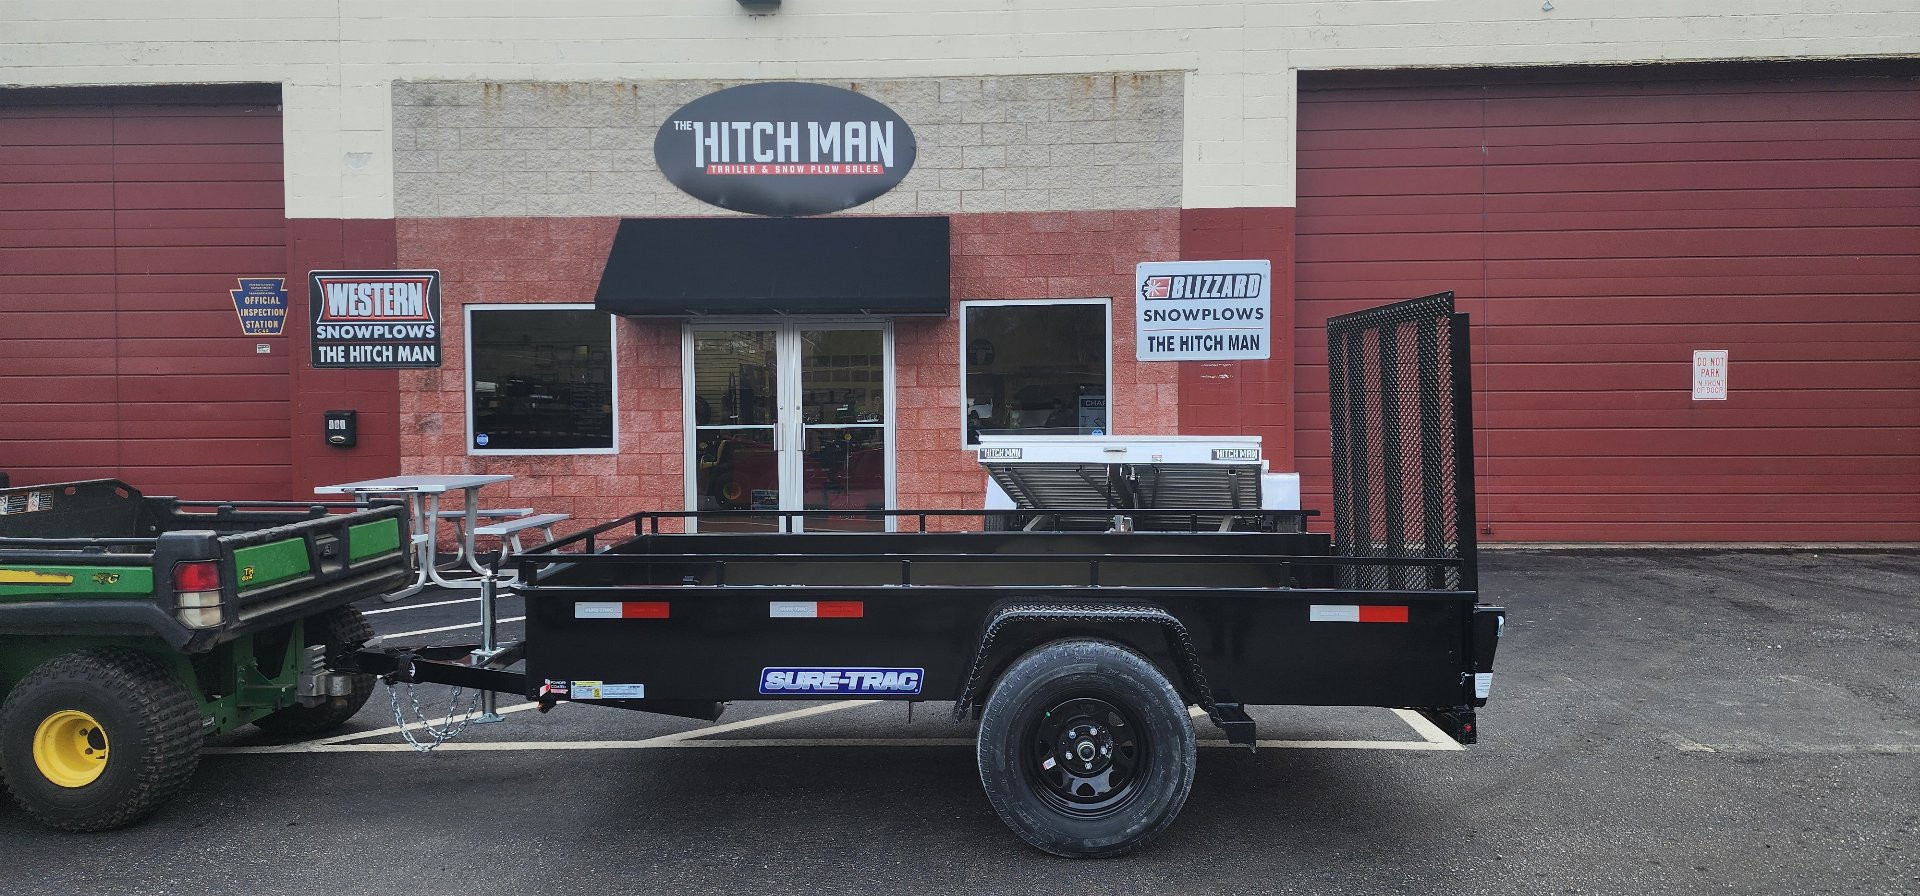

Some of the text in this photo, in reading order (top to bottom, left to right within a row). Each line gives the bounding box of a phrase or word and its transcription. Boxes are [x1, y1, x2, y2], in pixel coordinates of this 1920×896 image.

[673, 120, 894, 168] THE HITCH MAN
[711, 165, 879, 174] TRAILER & SNOW PLOW SALES
[1171, 274, 1261, 299] BLIZZARD
[244, 296, 280, 305] OFFICIAL
[326, 282, 423, 317] WESTERN
[240, 308, 284, 317] INSPECTION
[1143, 307, 1264, 322] SNOWPLOWS
[245, 320, 278, 329] STATION
[316, 325, 435, 339] SNOWPLOWS
[1147, 334, 1260, 353] THE HITCH MAN
[319, 345, 435, 363] THE HITCH MAN
[1697, 357, 1724, 367] DO NOT
[1701, 368, 1720, 378] PARK
[984, 448, 1004, 457] HITCH
[1216, 450, 1258, 459] HITCH MAN
[764, 671, 919, 691] SURE-TRAC
